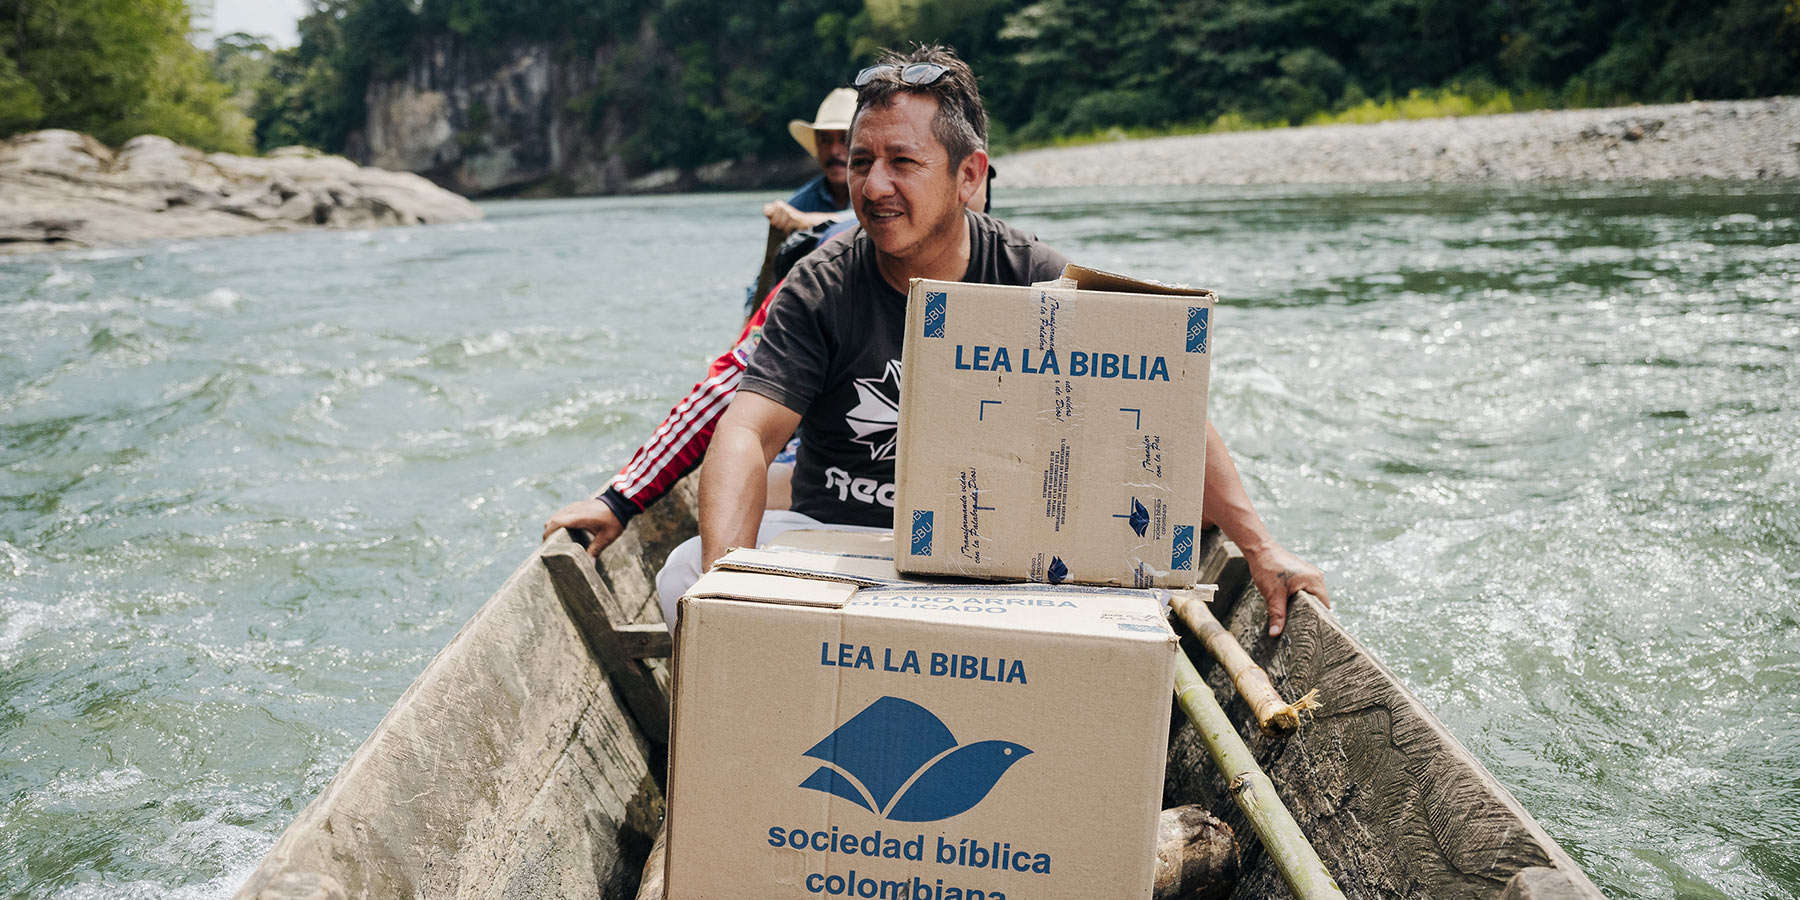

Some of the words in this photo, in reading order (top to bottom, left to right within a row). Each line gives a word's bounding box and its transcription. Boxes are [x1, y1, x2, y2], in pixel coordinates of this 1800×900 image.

[924, 304, 946, 326] SBU
[1040, 306, 1048, 314] la
[1040, 318, 1049, 350] Palabra
[1186, 318, 1208, 341] SBU
[955, 345, 1012, 372] LEA
[1022, 348, 1060, 375] LA
[1070, 351, 1170, 382] BIBLIA
[1055, 386, 1062, 396] de
[1056, 400, 1064, 422] Dios!
[1154, 454, 1160, 462] la
[968, 467, 976, 489] Dios!
[912, 522, 932, 544] SBU
[960, 496, 972, 558] ¡Transformando
[972, 540, 979, 548] la
[1172, 536, 1193, 558] SBU
[852, 602, 1007, 613] DELICADO
[872, 595, 954, 603] LADO
[962, 597, 1078, 608] ARRIBA
[821, 642, 874, 670] LEA
[884, 648, 920, 674] LA
[930, 652, 1027, 684] BIBLIA
[767, 826, 924, 861] sociedad
[936, 836, 1051, 874] bíblica
